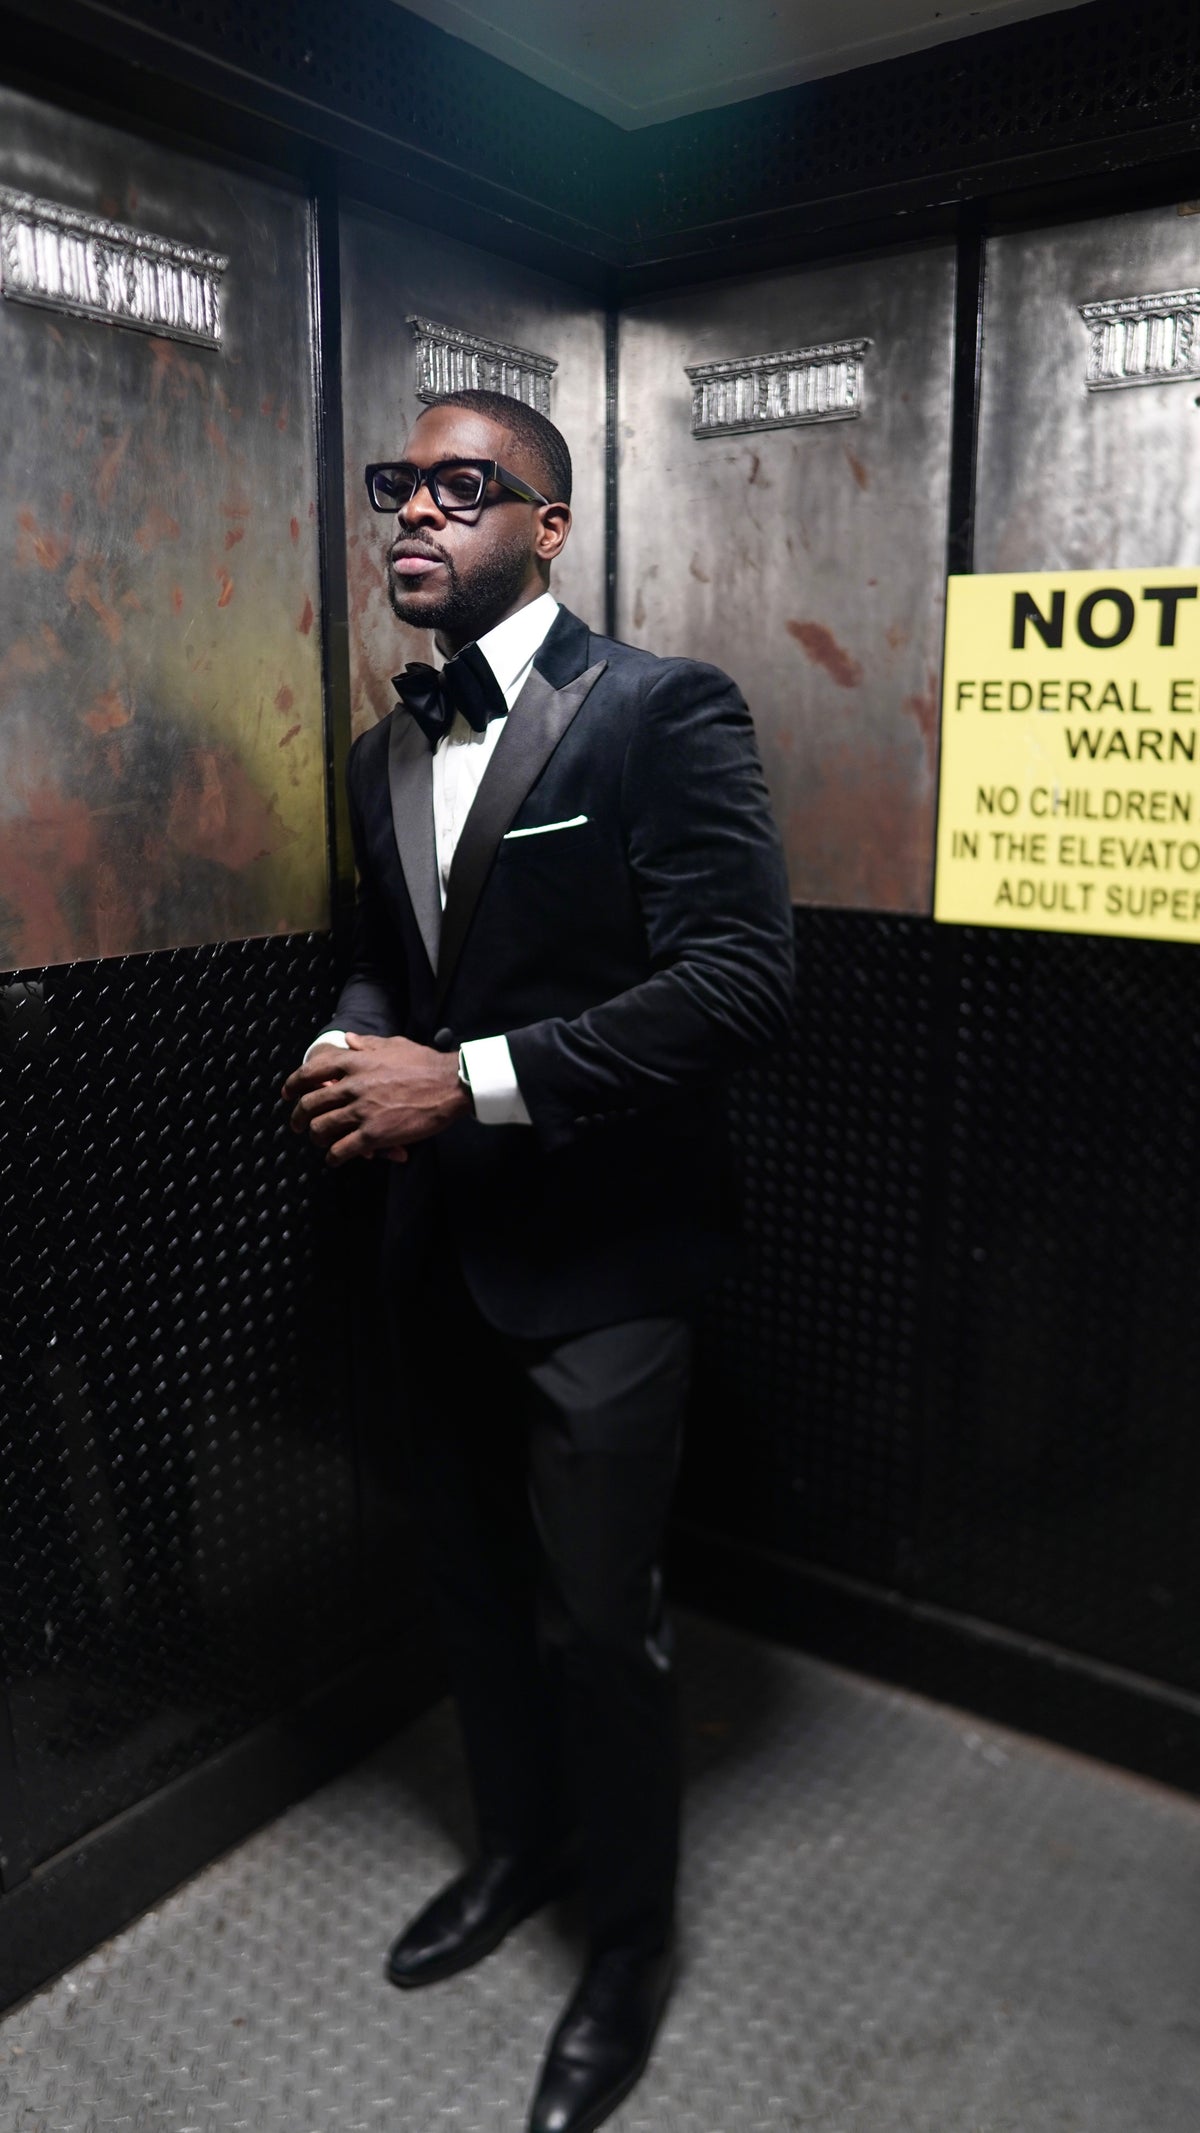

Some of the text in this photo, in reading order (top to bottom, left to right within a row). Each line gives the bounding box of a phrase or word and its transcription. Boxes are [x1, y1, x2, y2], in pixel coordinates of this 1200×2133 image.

[1010, 586, 1198, 650] NOT
[955, 680, 1200, 714] FEDERAL E
[1065, 728, 1196, 762] WARN
[976, 786, 1192, 823] NO CHILDREN
[952, 831, 1200, 873] IN THE ELEVATO
[995, 879, 1095, 912] ADULT
